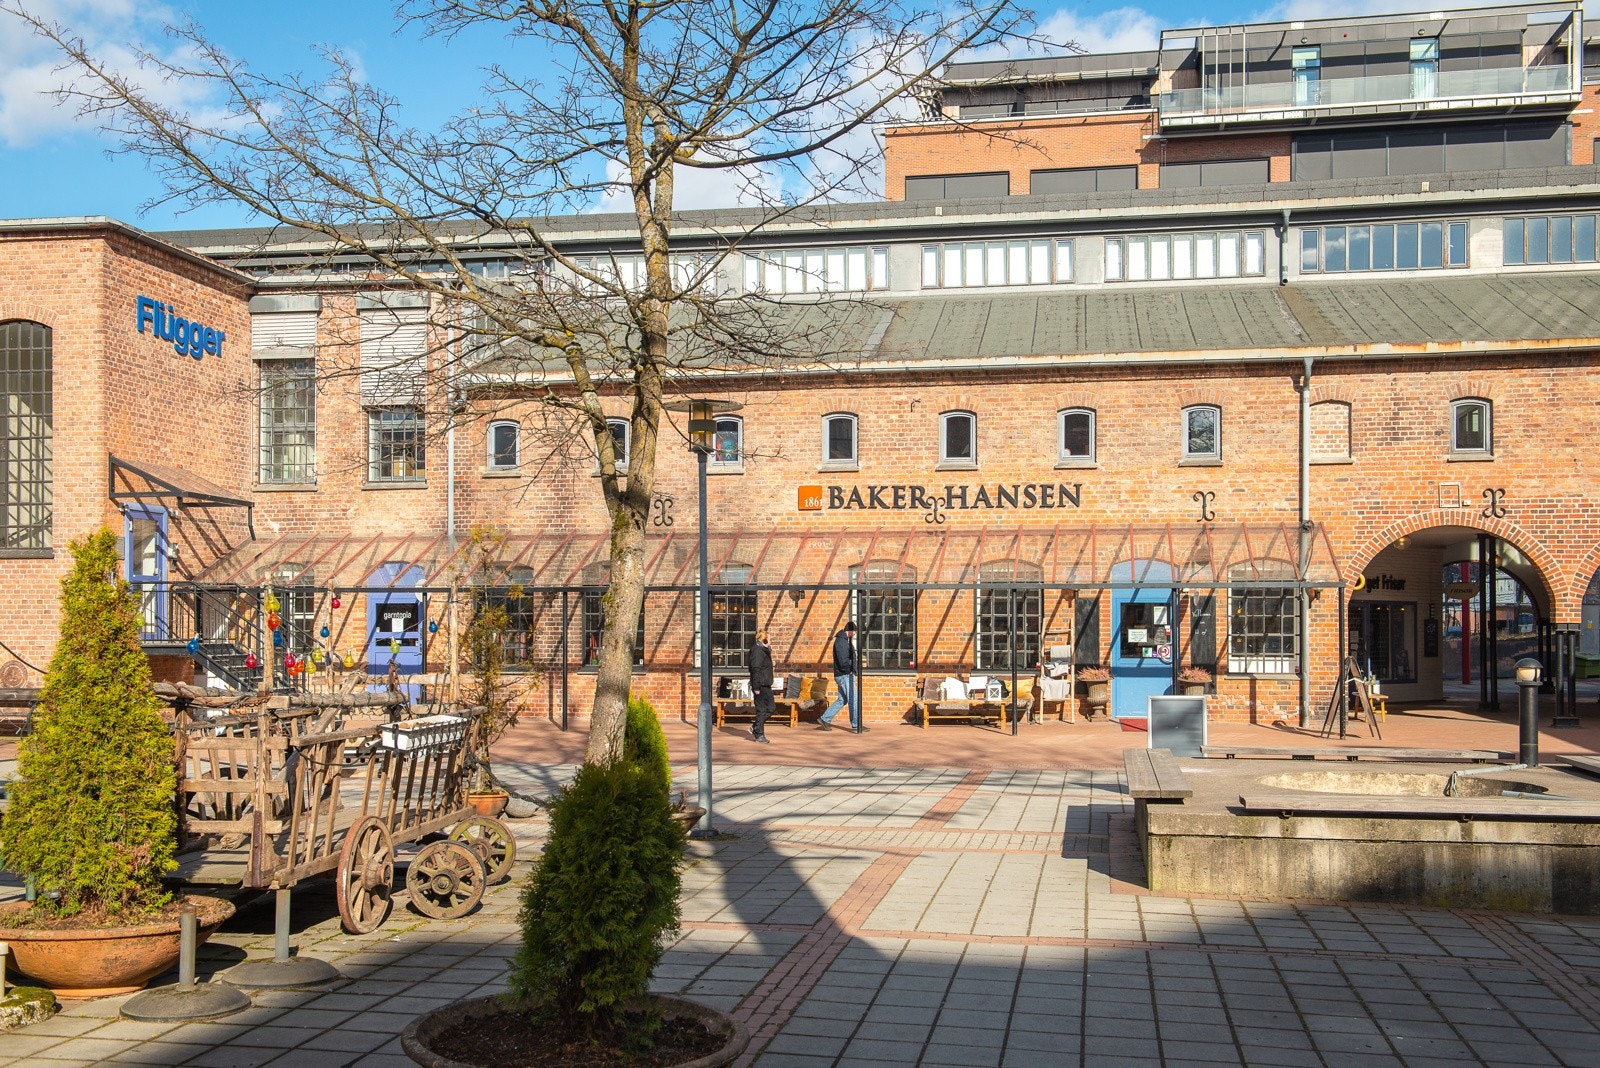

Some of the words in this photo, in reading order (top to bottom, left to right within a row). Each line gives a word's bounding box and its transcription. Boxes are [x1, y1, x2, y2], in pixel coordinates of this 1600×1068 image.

[136, 294, 226, 361] Flügger
[804, 496, 823, 508] 1861
[827, 485, 929, 510] BAKER
[944, 483, 1083, 510] HANSEN
